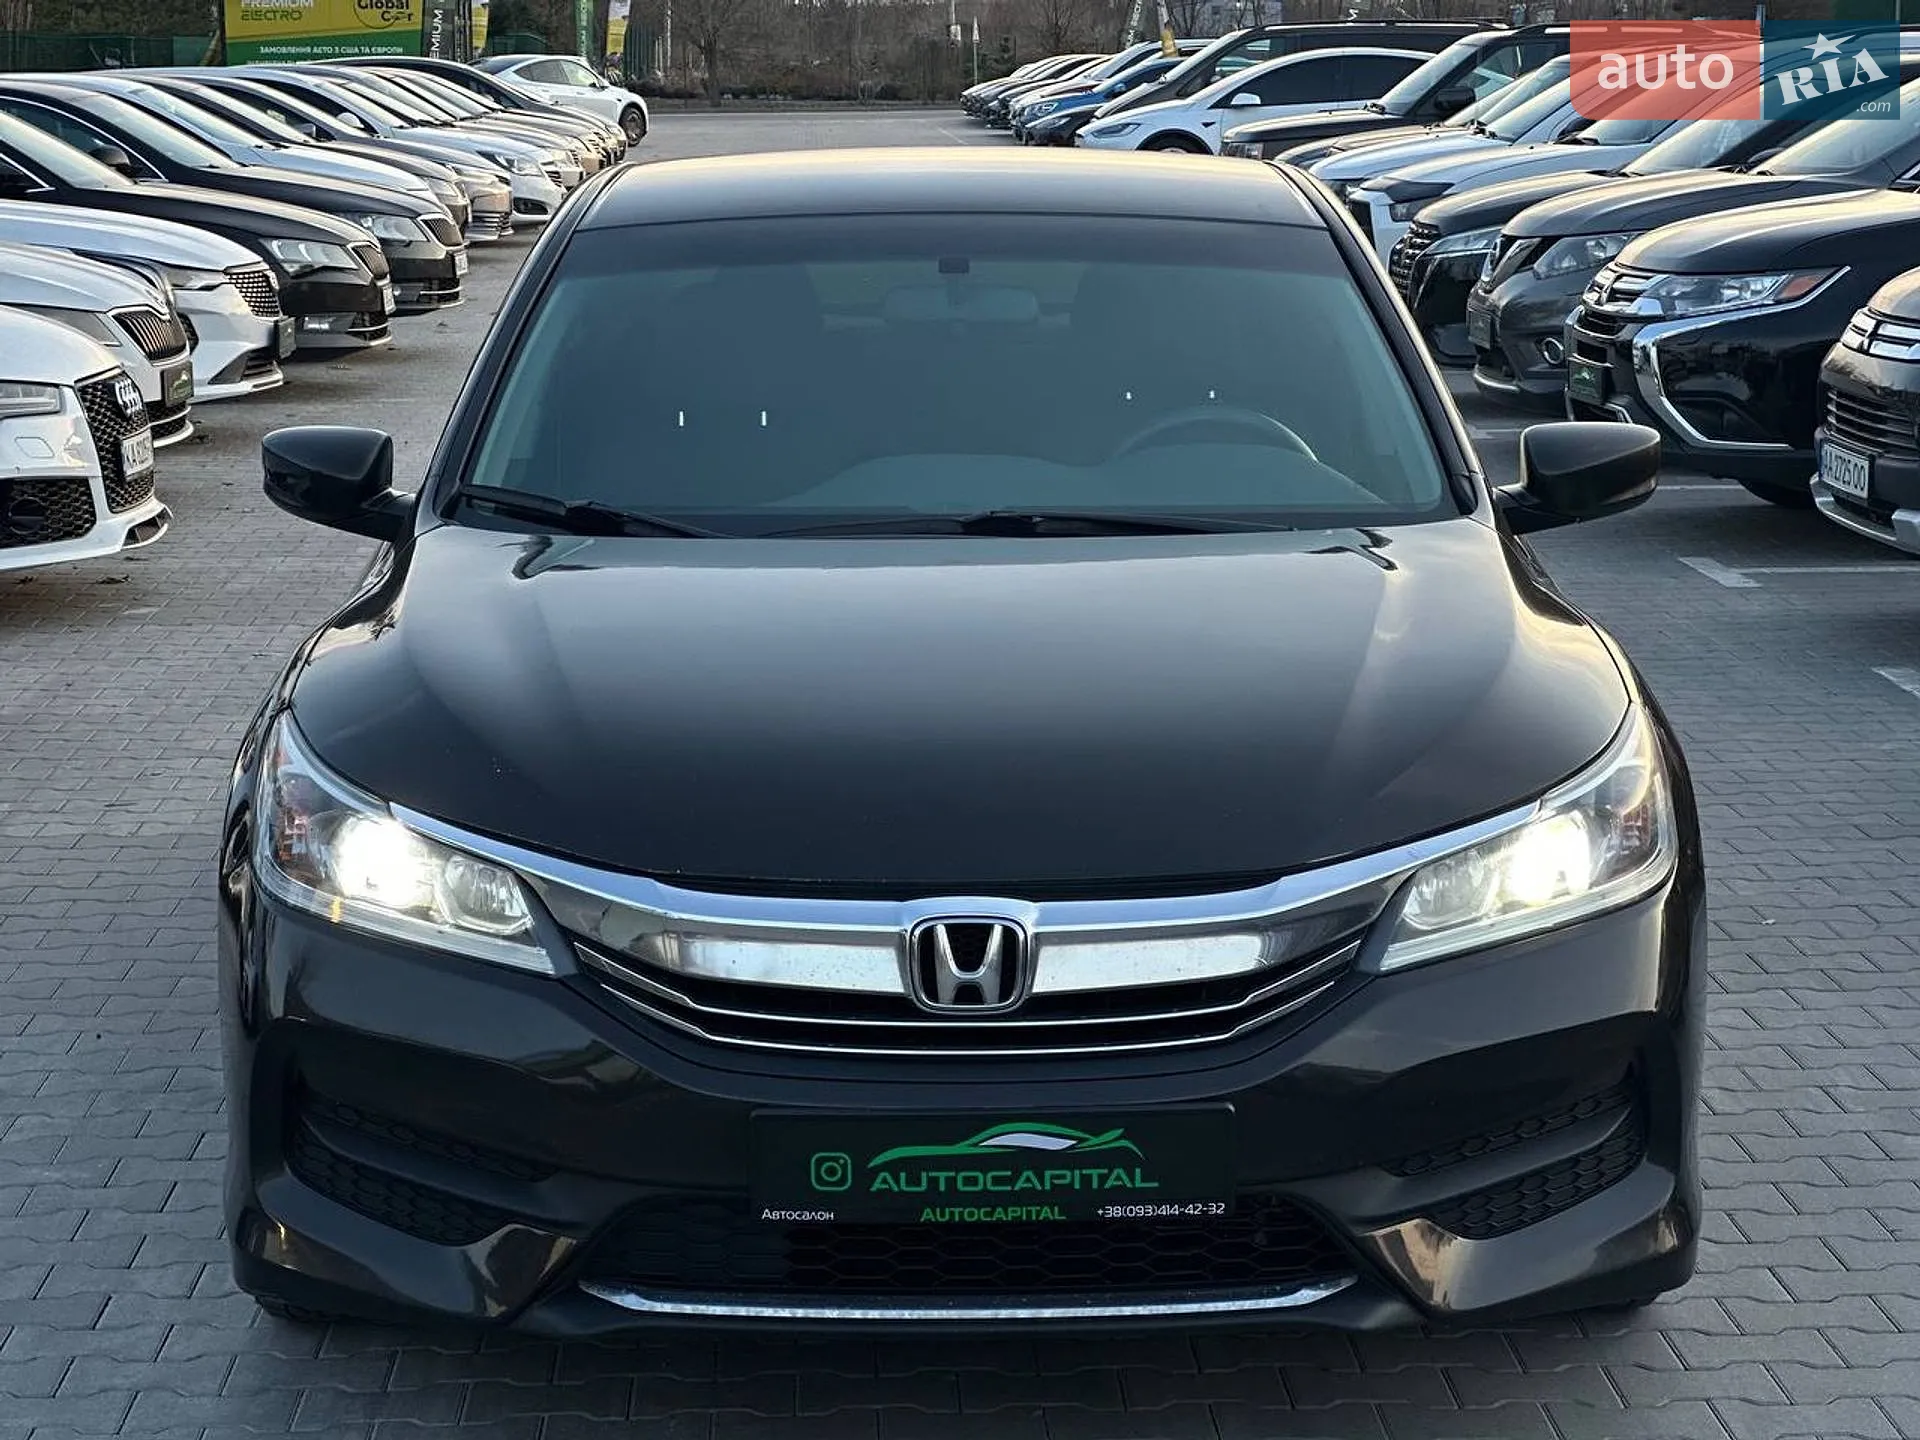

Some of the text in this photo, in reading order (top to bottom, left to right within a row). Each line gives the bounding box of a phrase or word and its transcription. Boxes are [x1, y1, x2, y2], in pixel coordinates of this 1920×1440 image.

[869, 1167, 1159, 1193] AUTOCAPITAL
[761, 1208, 835, 1222] Автосалон
[920, 1205, 1066, 1222] AUTOCAPITAL
[1096, 1202, 1225, 1218] +38(093)414-42-32
